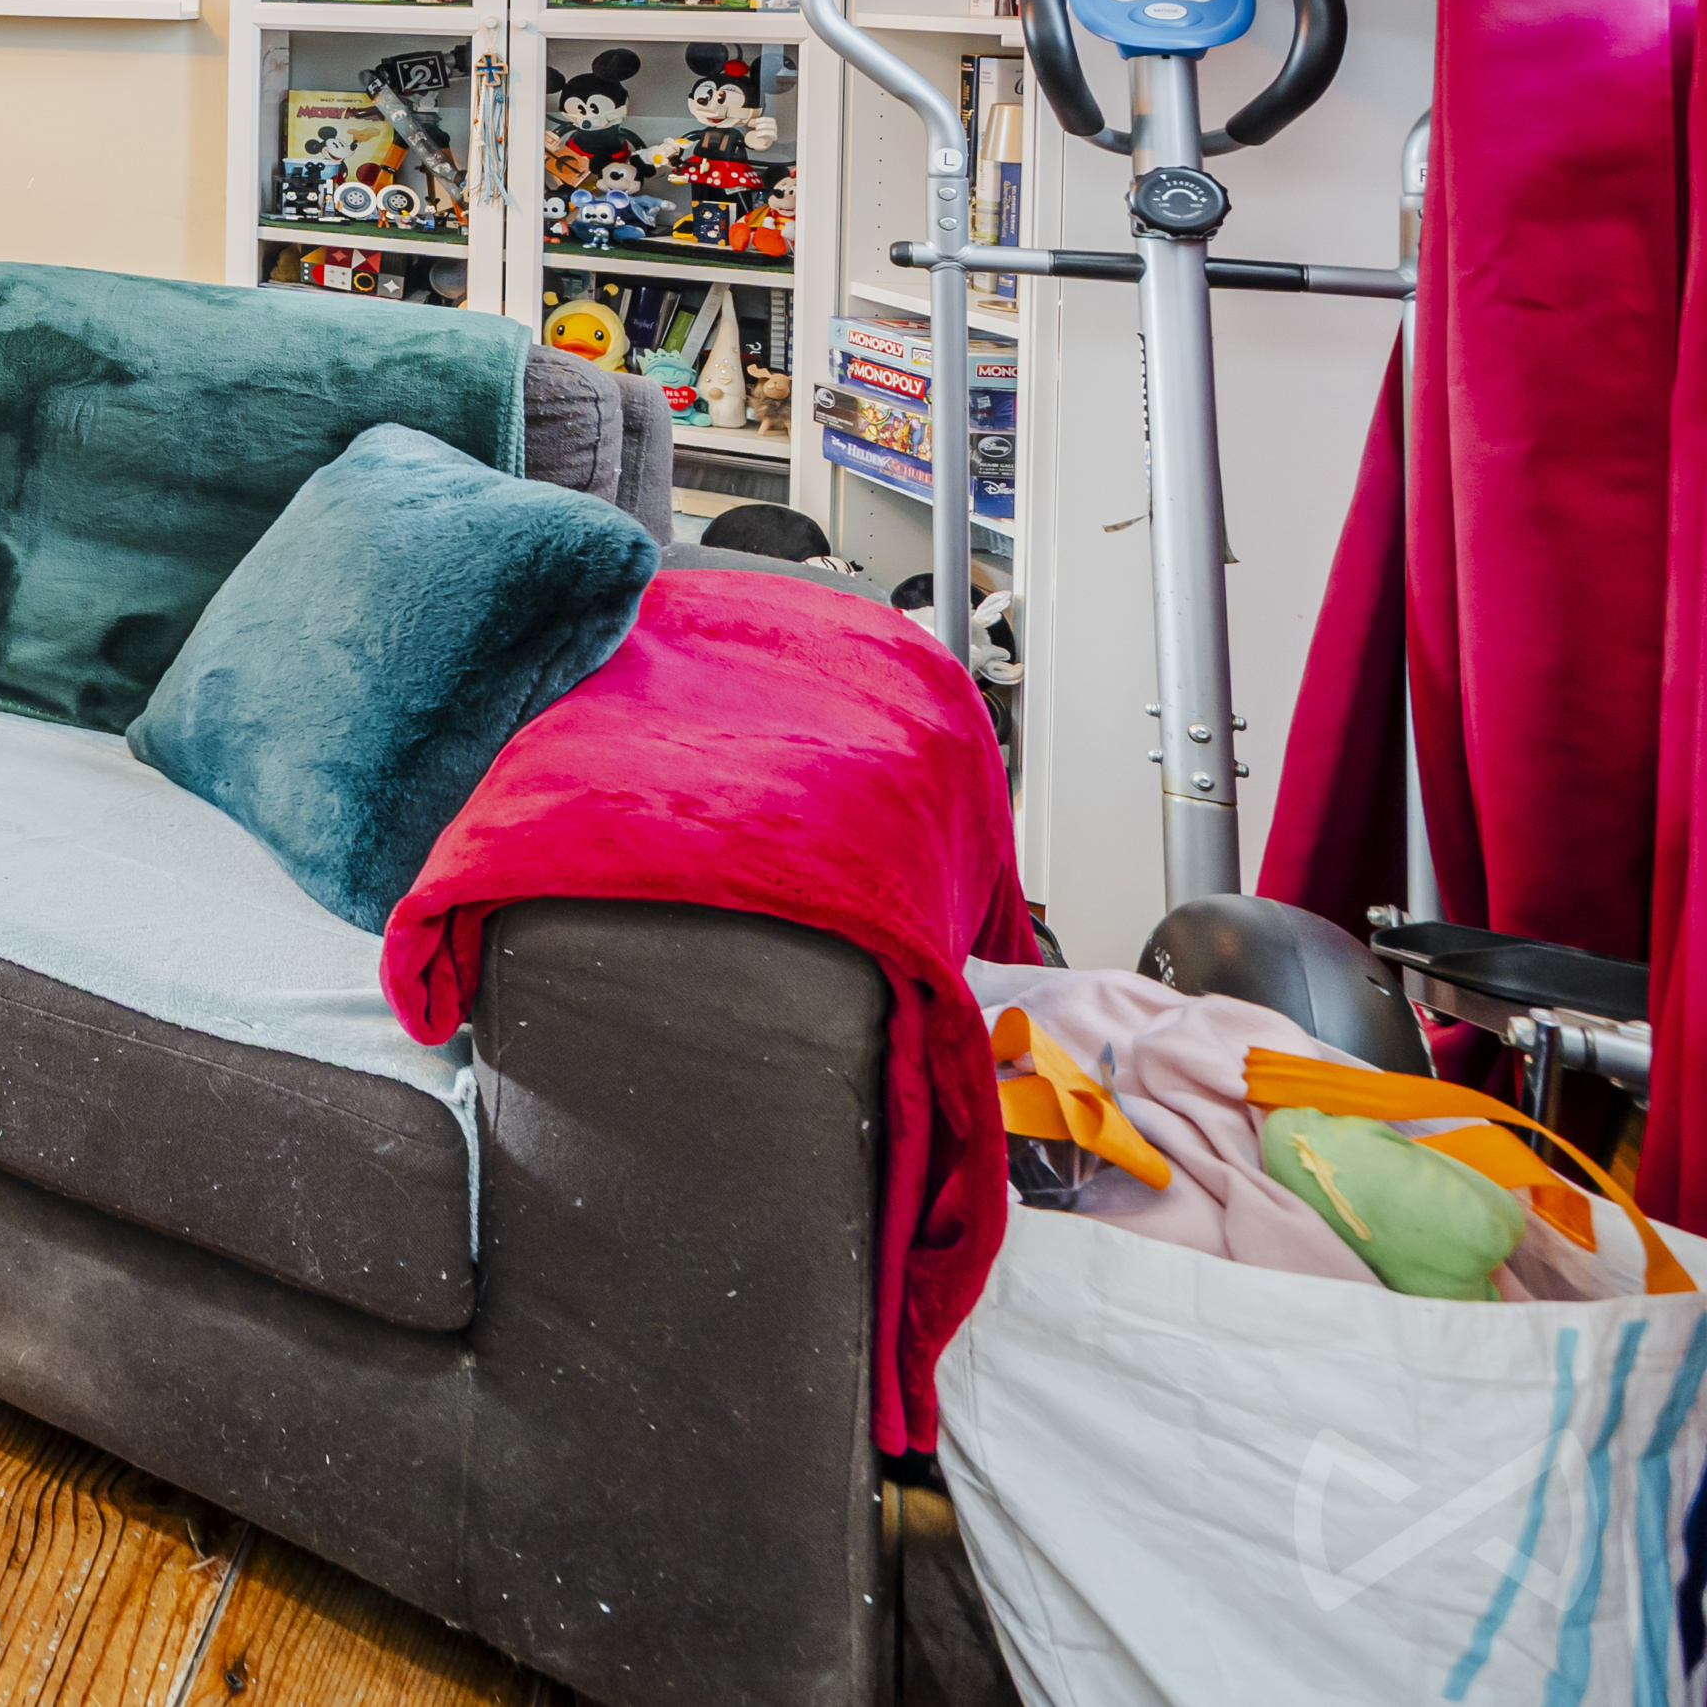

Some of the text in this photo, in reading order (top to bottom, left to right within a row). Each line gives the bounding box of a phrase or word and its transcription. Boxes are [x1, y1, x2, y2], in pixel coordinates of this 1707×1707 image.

[849, 331, 904, 358] MONOPOLY
[665, 388, 689, 397] NEW
[854, 362, 923, 396] MONOPOLY
